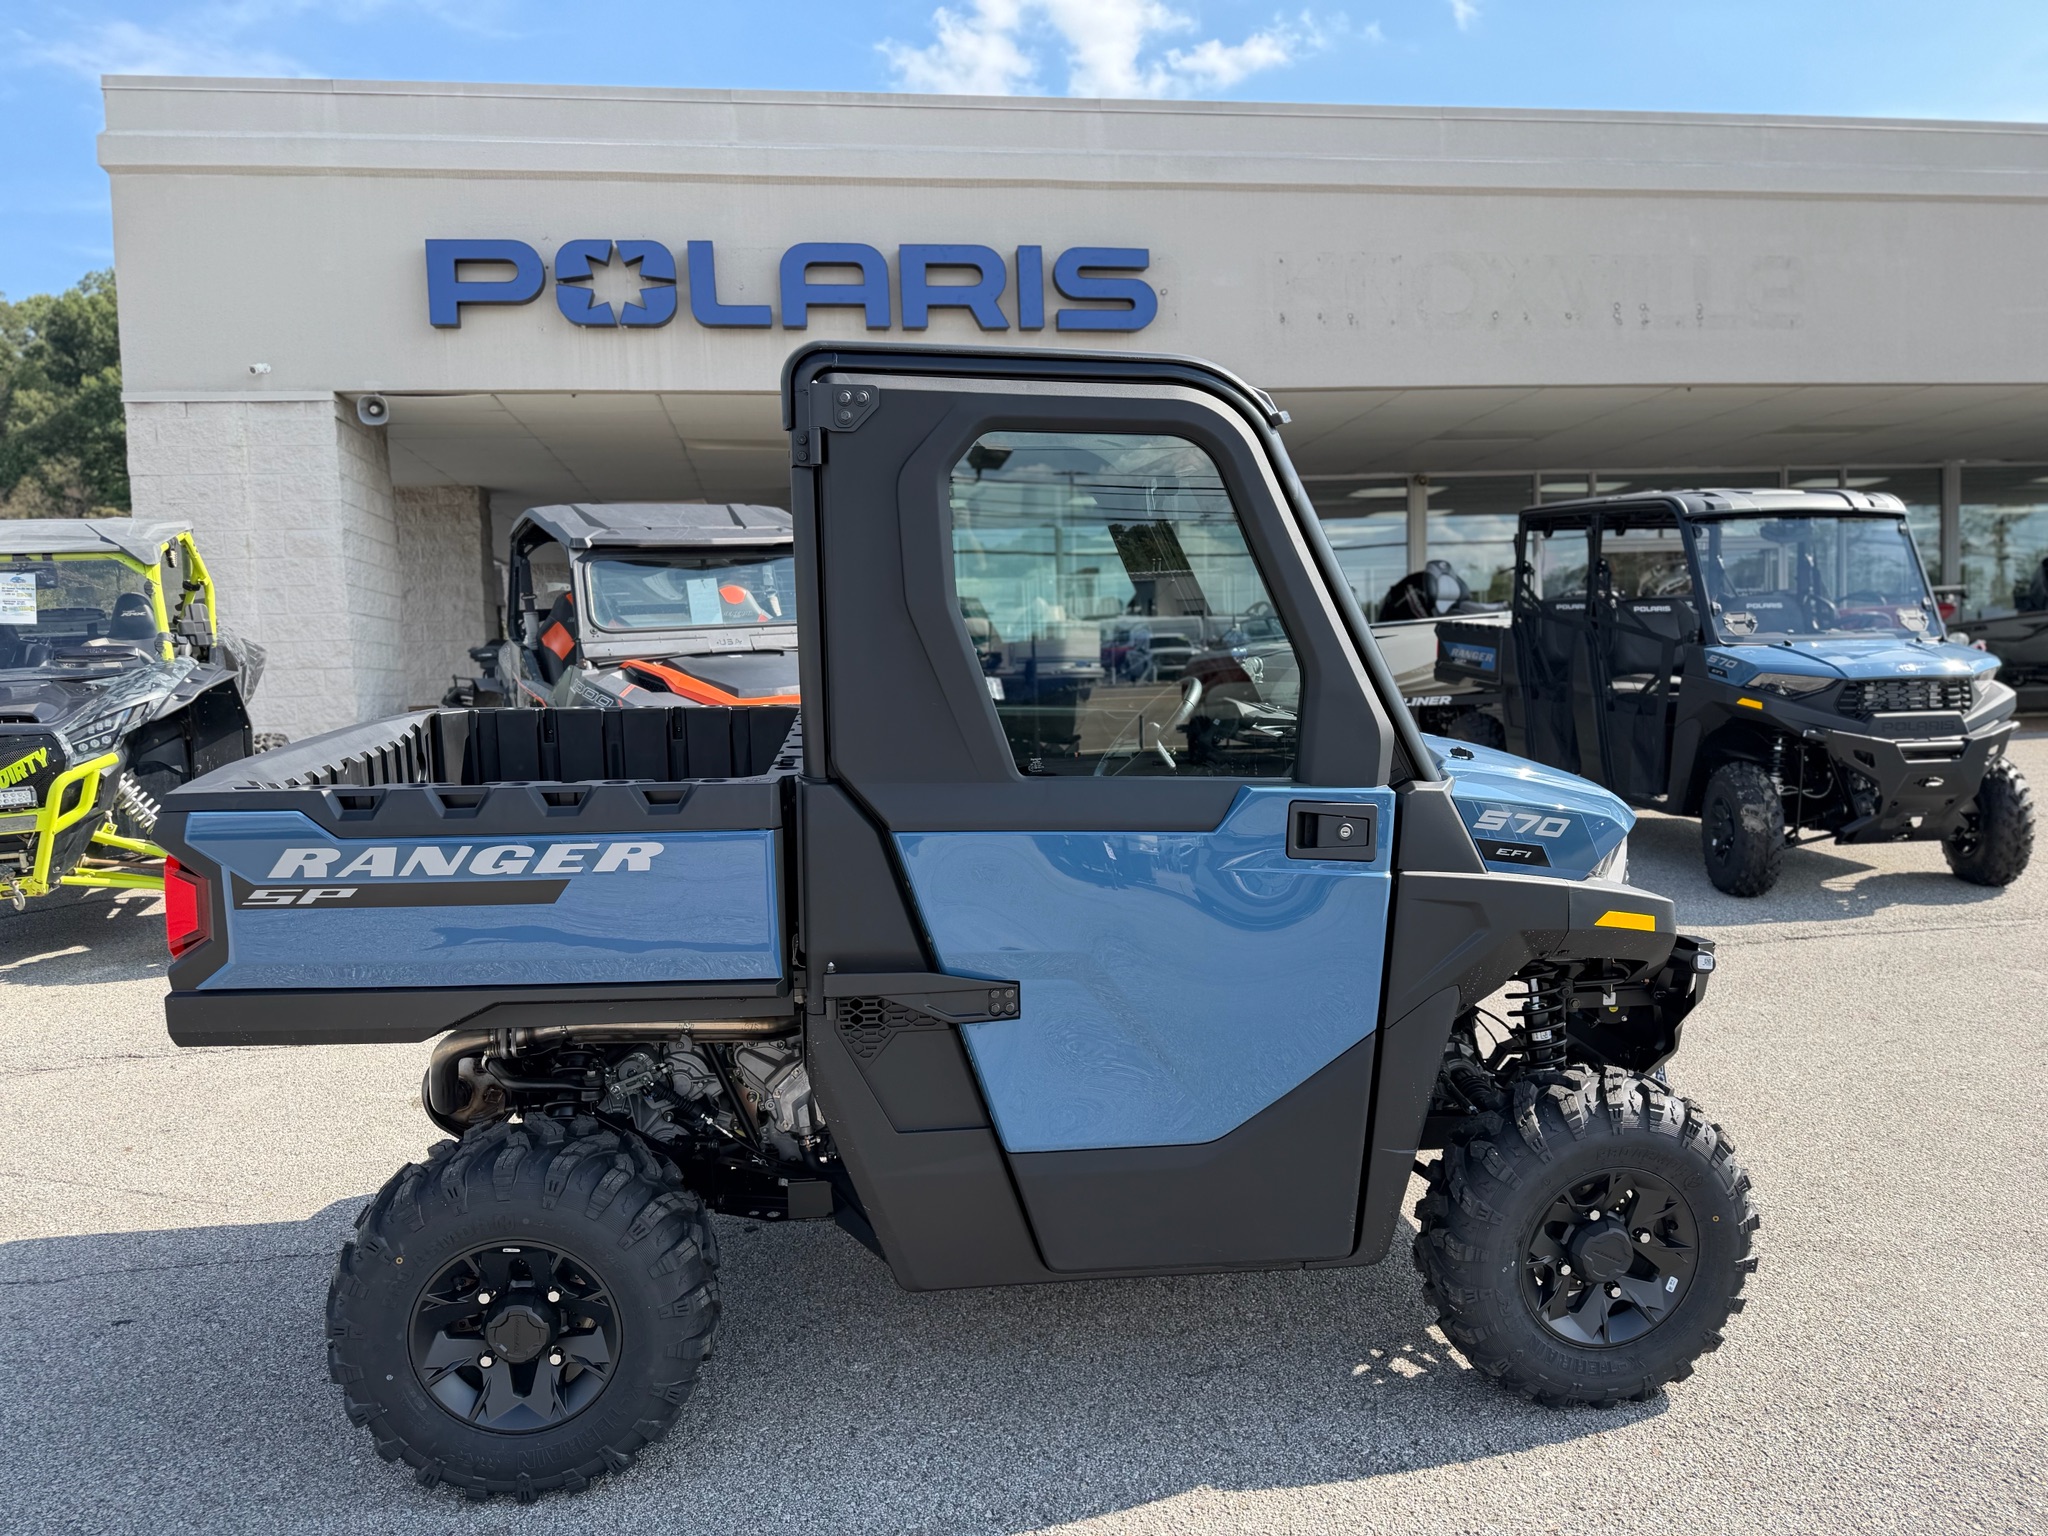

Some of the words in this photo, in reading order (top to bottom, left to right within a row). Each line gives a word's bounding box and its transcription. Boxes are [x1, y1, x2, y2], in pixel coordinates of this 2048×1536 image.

[425, 238, 1159, 333] POLARIS
[1556, 603, 1586, 611] POLARI
[1633, 605, 1672, 614] POLARIS
[1746, 602, 1783, 610] POLARIS
[1451, 648, 1494, 662] RANGER
[1706, 653, 1738, 670] 570
[1472, 809, 1571, 838] 570
[266, 840, 665, 879] RANGER
[1495, 847, 1532, 859] EFI
[242, 887, 359, 906] SP
